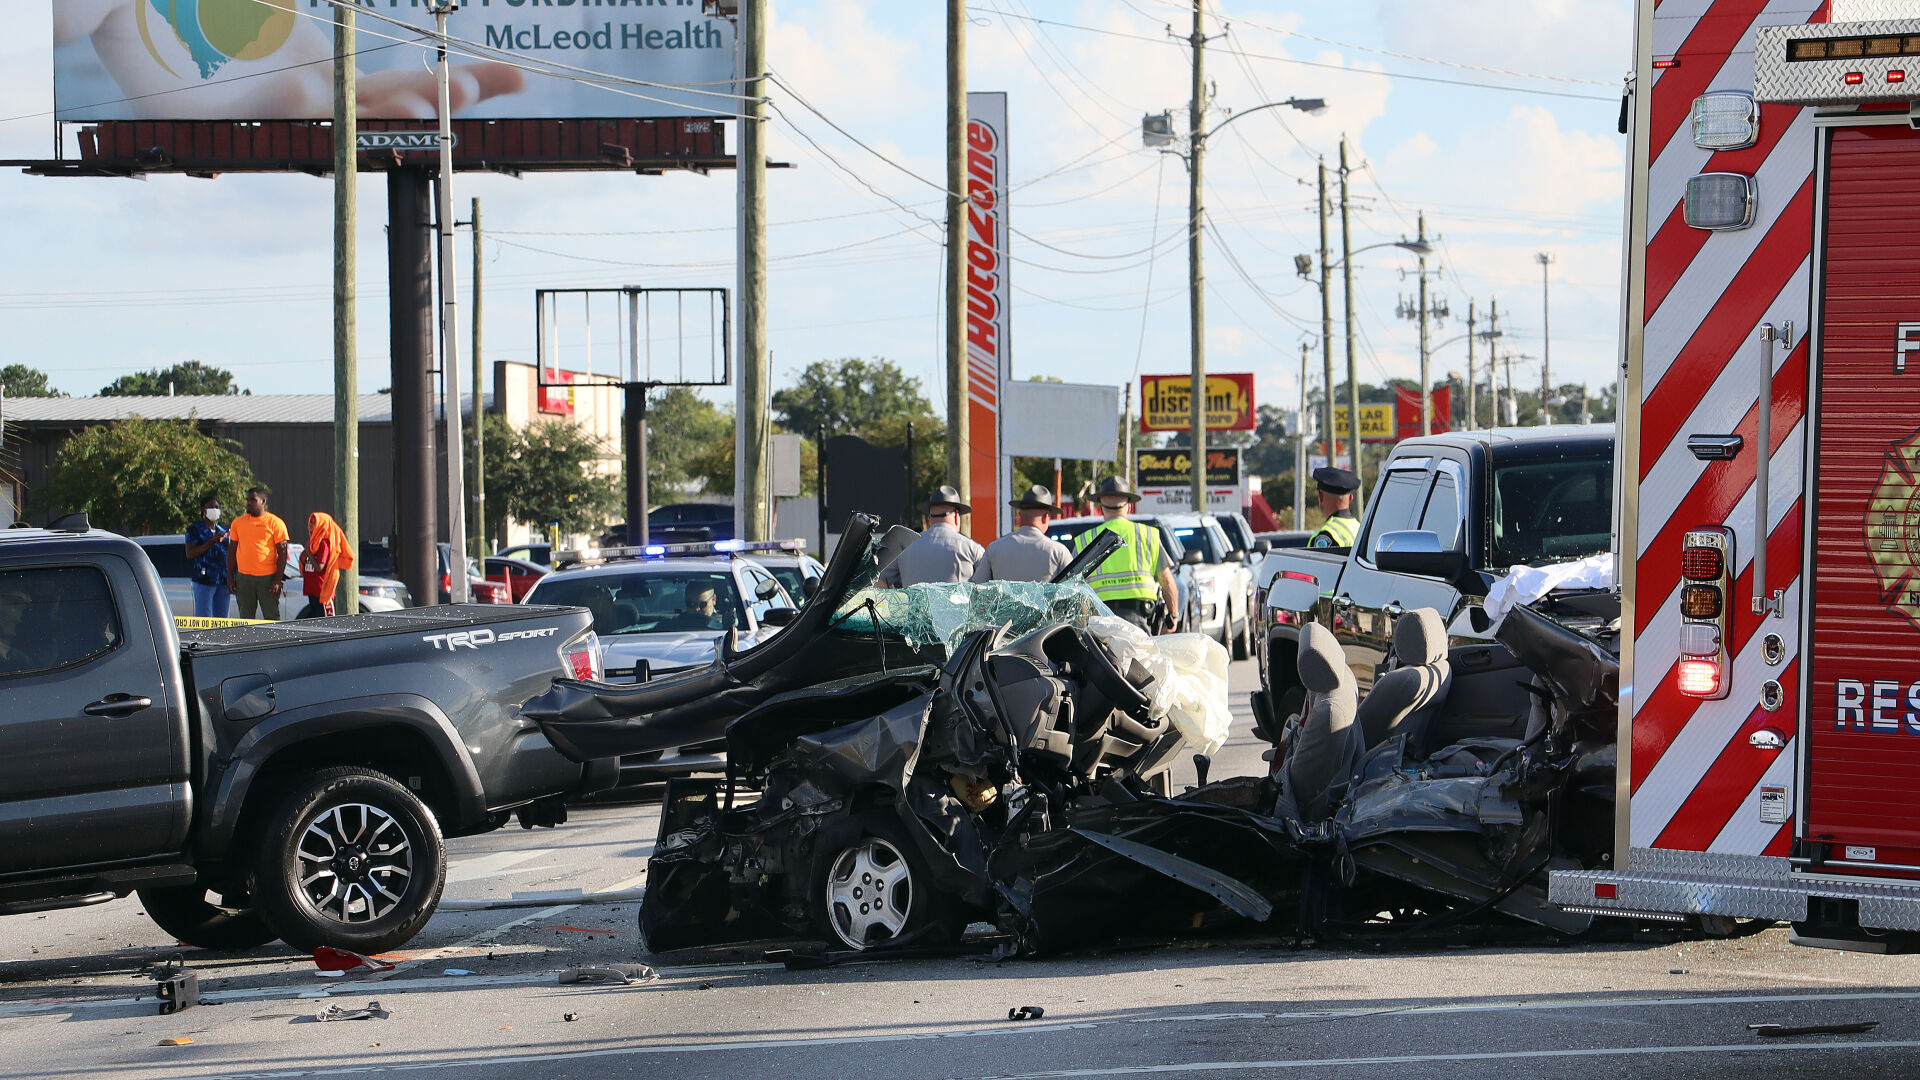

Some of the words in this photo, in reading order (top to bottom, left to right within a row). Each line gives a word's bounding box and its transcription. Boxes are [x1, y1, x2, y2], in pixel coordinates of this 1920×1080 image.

[485, 22, 612, 50] McLeod
[621, 20, 722, 49] Health
[189, 619, 200, 627] NOT
[201, 619, 209, 628] DO
[422, 628, 496, 652] TRD
[497, 627, 559, 642] SPORT
